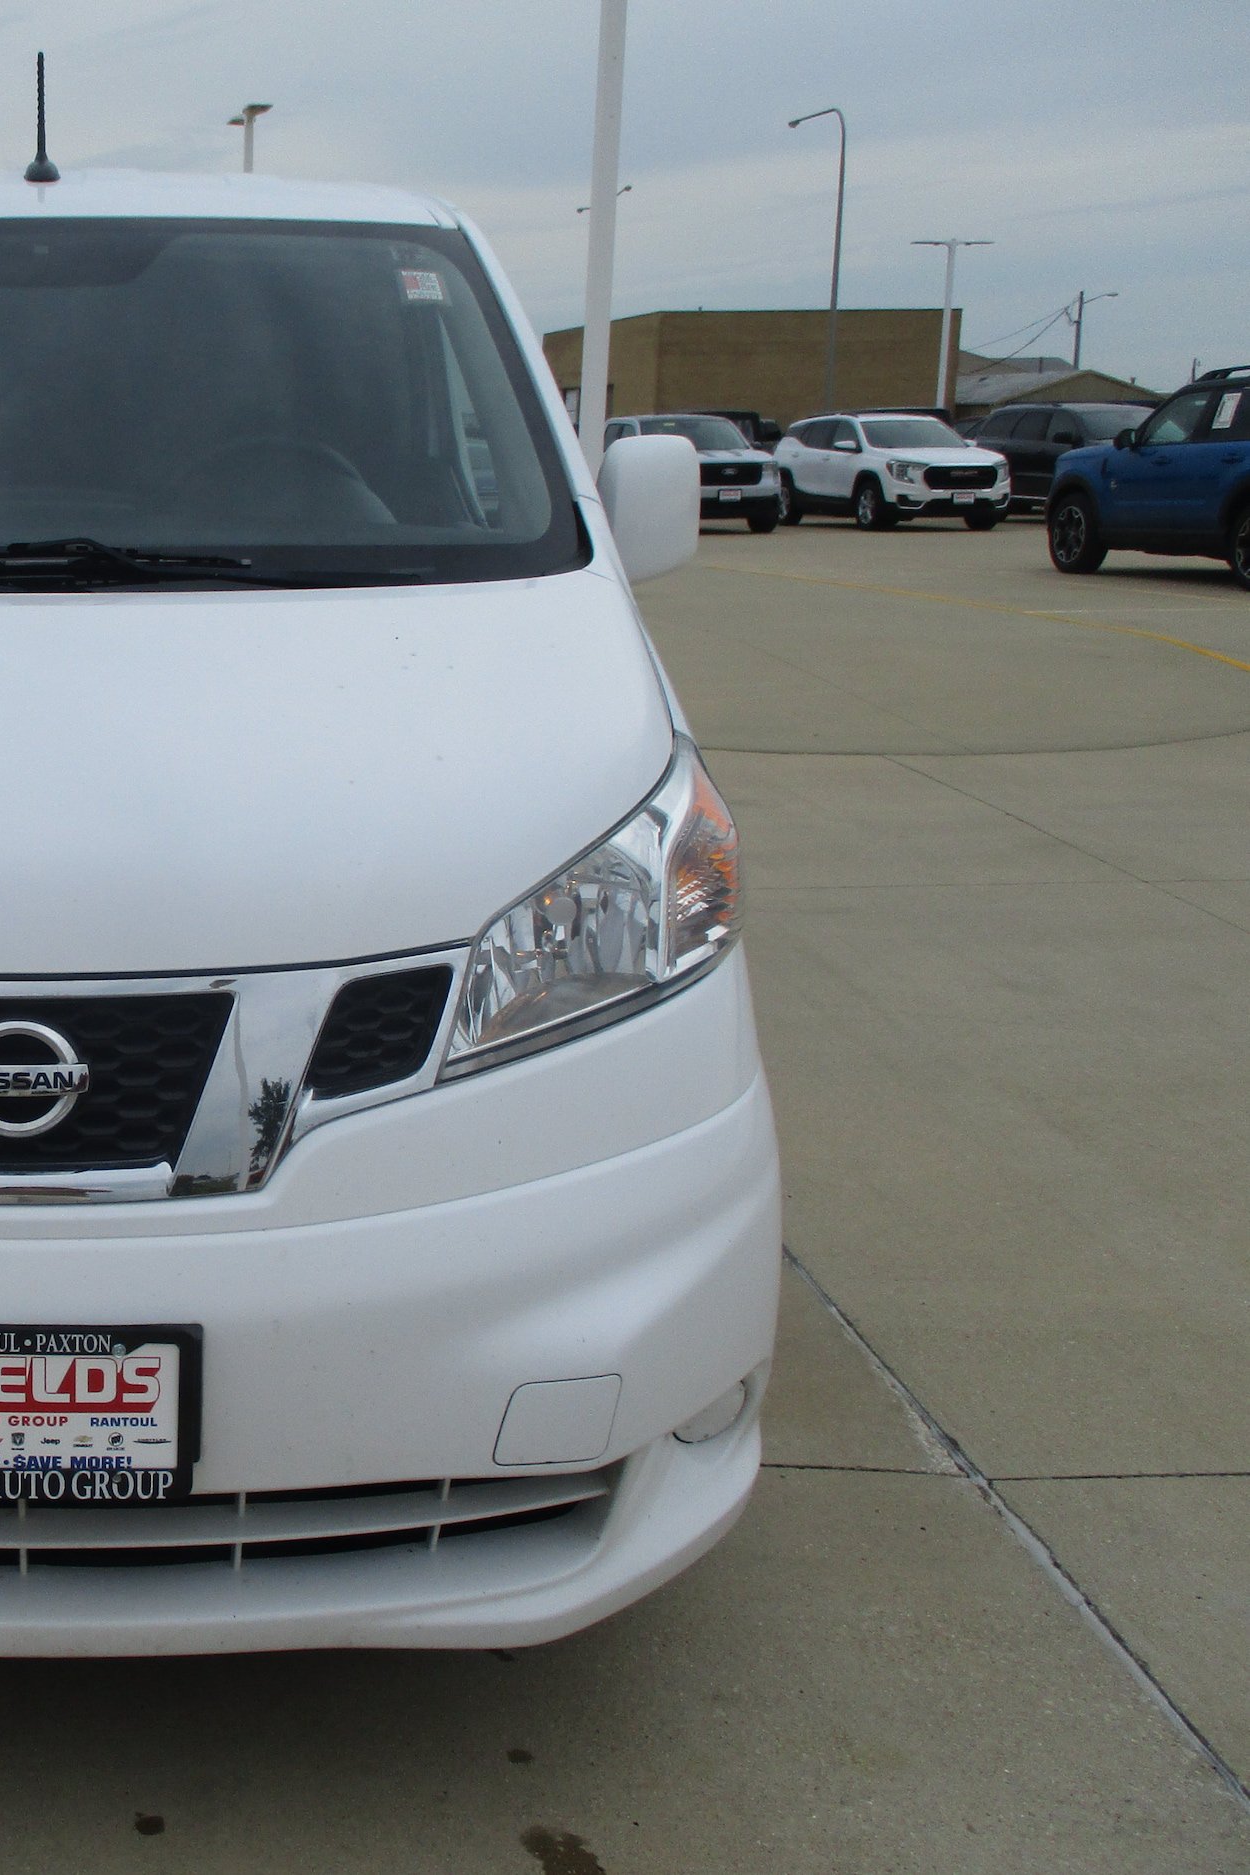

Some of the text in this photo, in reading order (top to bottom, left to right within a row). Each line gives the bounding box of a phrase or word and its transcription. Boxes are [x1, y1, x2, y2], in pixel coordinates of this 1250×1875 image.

[36, 1333, 112, 1353] PAXTON
[8, 1415, 68, 1427] GROUP
[90, 1417, 158, 1427] RANTOUL
[40, 1437, 61, 1446] Jeep
[70, 1456, 132, 1469] MORE!
[71, 1469, 174, 1500] GROUP
